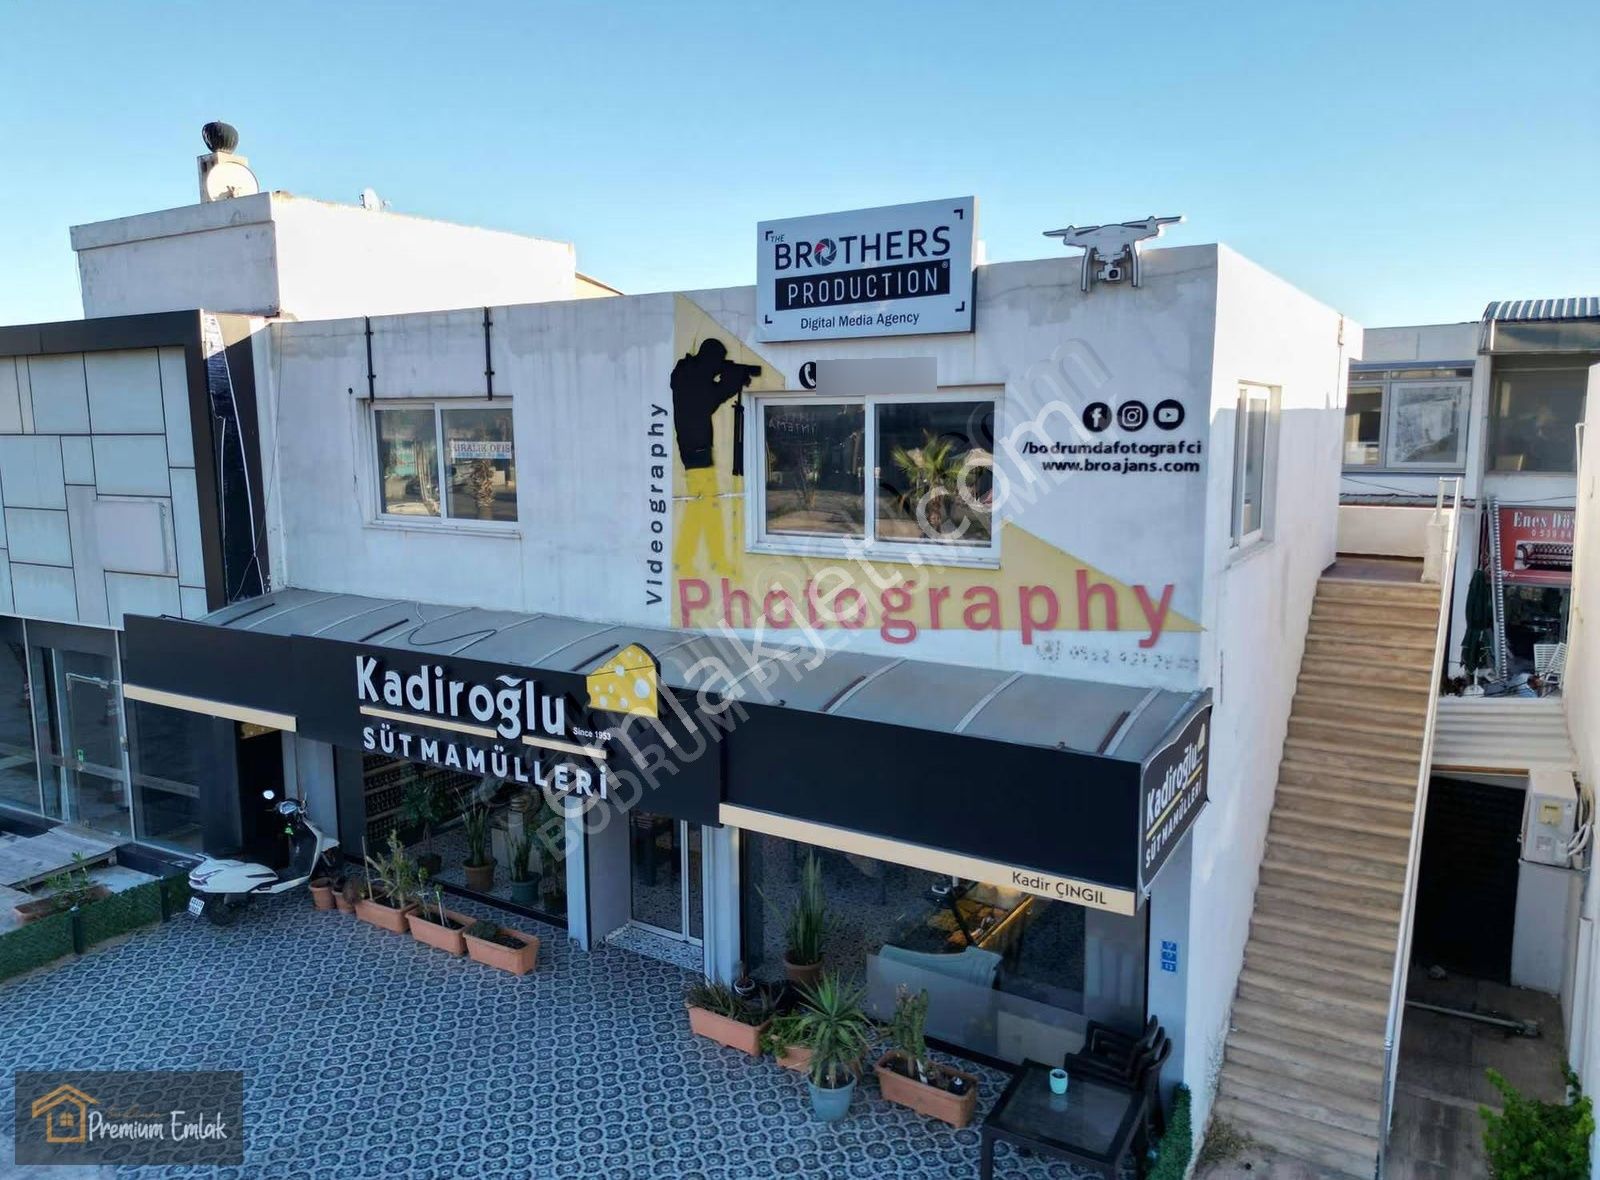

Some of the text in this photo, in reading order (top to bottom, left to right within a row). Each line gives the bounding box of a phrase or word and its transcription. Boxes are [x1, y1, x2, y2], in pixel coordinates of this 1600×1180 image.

[770, 234, 785, 243] THE
[775, 226, 951, 271] BROTHERS
[788, 267, 938, 306] PRODUCTION
[800, 312, 920, 331] Digital Media Agency
[1042, 458, 1200, 474] www.broajans.com
[646, 404, 668, 606] Videography
[1513, 511, 1576, 530] Enes Dö
[678, 569, 1175, 648] Photography
[354, 655, 567, 740] Kadiroğlu
[362, 724, 414, 756] SÜT
[572, 726, 612, 741] Since 1953
[1146, 742, 1198, 825] Kadiroğlu
[1012, 871, 1051, 892] Kadir
